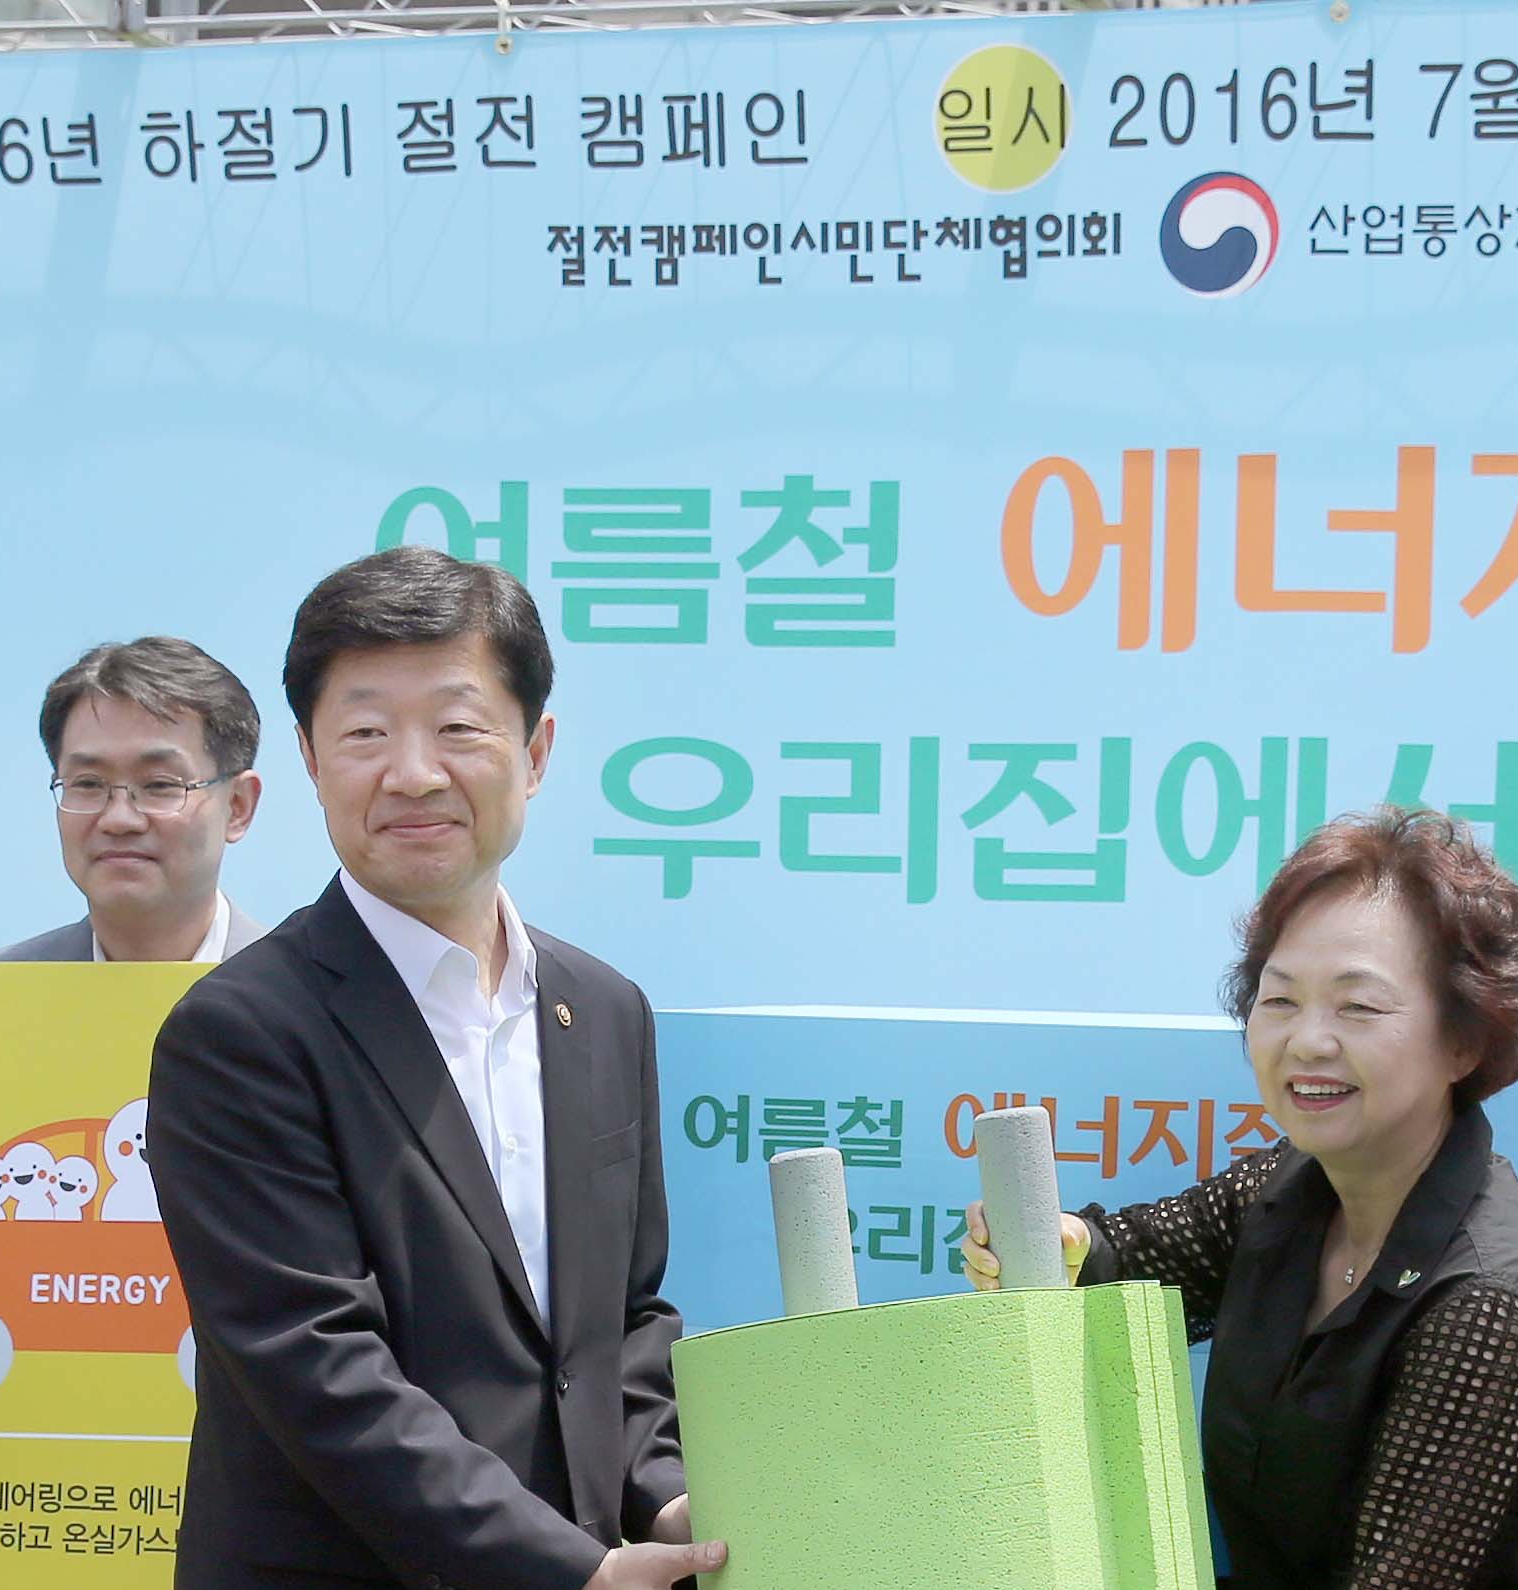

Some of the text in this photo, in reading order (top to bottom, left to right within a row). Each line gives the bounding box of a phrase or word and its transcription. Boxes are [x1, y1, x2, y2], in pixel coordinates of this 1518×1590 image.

[139, 102, 353, 184] 하절기
[396, 93, 538, 174] 절전
[580, 88, 809, 169] 캠페인
[937, 82, 1067, 154] 일시
[1108, 57, 1376, 149] 2016년
[546, 210, 1122, 287] 절전캠페인시민단체협의회
[683, 1093, 905, 1169] 여름철
[29, 1272, 171, 1306] ENERGY
[61, 1522, 181, 1555] 온실가스
